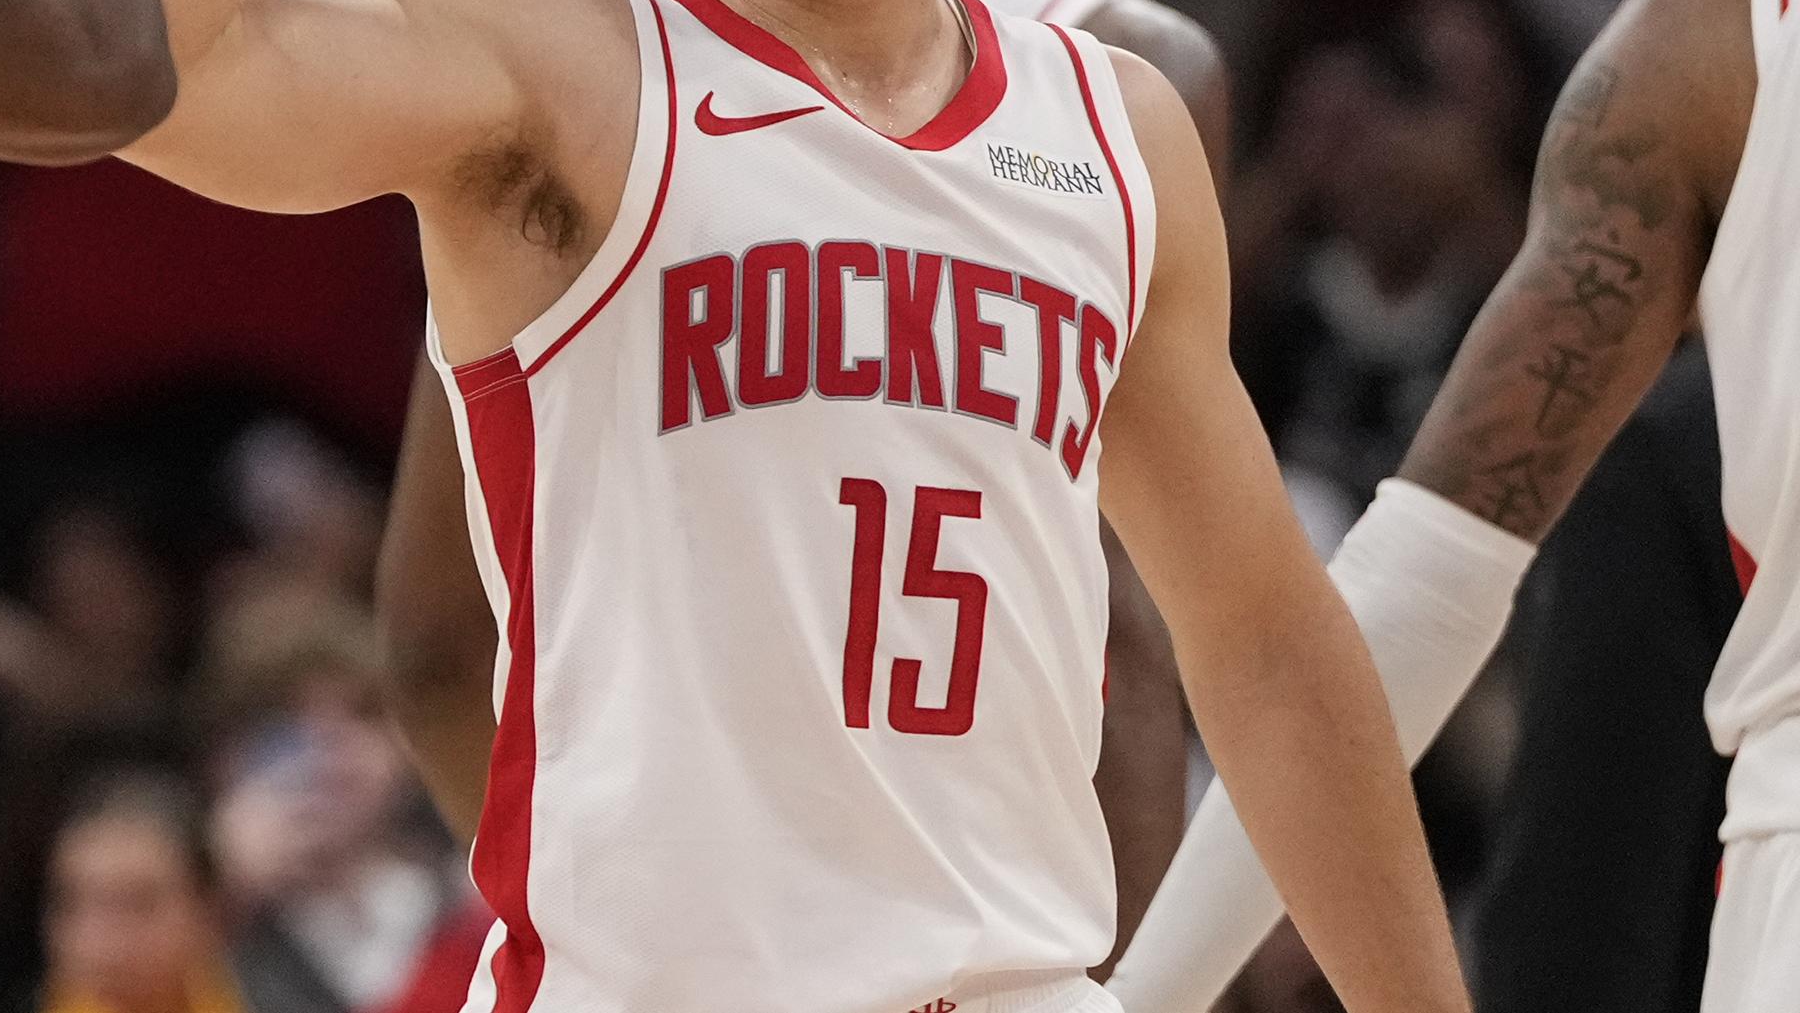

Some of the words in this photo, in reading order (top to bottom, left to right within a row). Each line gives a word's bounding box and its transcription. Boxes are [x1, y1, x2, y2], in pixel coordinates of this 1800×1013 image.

[986, 142, 1100, 179] MEMORIAL
[991, 159, 1104, 194] HERMANN
[658, 239, 1122, 483] ROCKETS
[839, 477, 989, 736] 15
